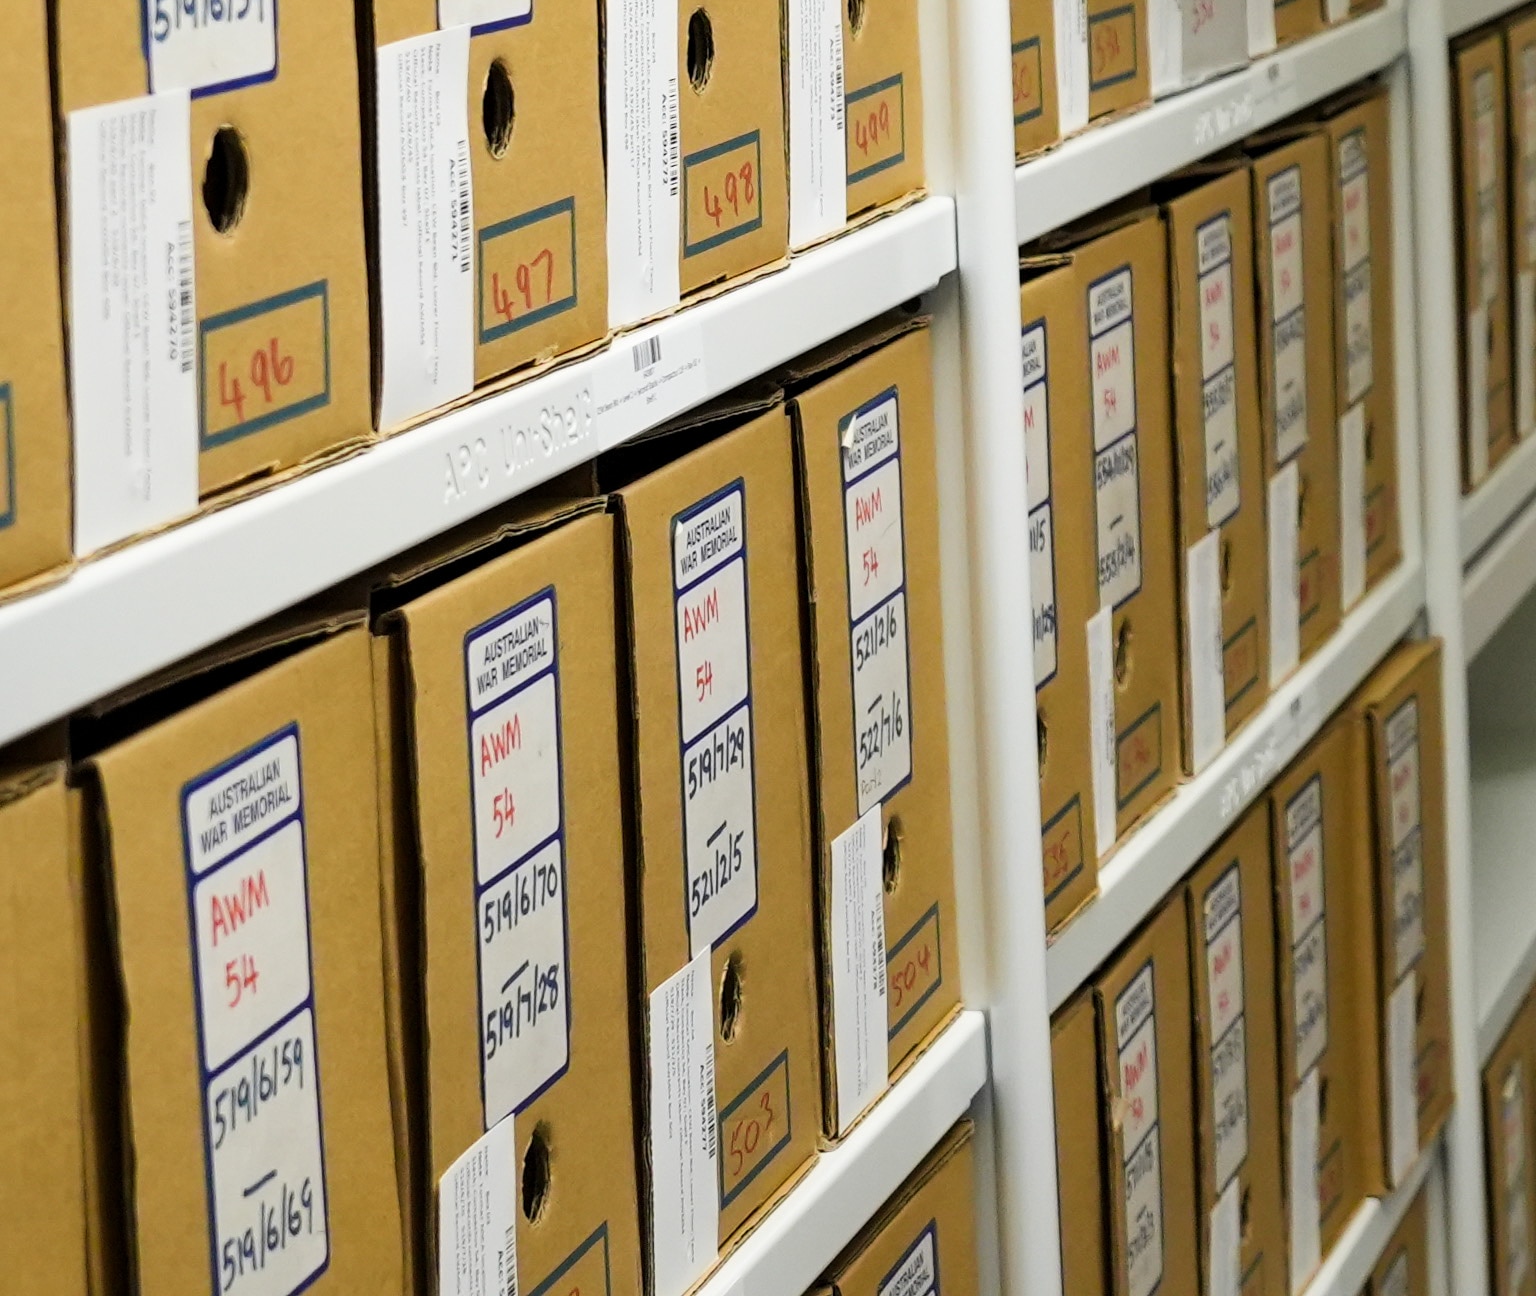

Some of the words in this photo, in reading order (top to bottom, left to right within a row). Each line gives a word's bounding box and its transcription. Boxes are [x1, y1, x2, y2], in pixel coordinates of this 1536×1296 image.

[856, 101, 890, 155] 499
[704, 160, 754, 229] 498
[168, 241, 176, 281] Acc:
[491, 248, 553, 322] 497
[219, 337, 293, 423] 496
[855, 487, 883, 532] AWM
[862, 550, 879, 588] 54
[683, 587, 719, 643] AWM
[856, 606, 897, 673] 521/2/6
[696, 659, 713, 703] 54
[481, 713, 522, 777] AWM
[688, 725, 745, 800] 519/7/29
[860, 697, 904, 772] 522/7/6
[201, 822, 228, 853] WAR
[234, 787, 292, 832] MEMORIAL
[209, 757, 281, 818] AUSTRALIAN
[492, 787, 516, 839] 54
[210, 869, 269, 946] AWM
[484, 863, 558, 944] 519/6/70
[691, 830, 744, 918] 521/2/5
[225, 953, 260, 1008] 54
[214, 1037, 304, 1151] 519/6/59
[730, 1091, 773, 1176] 503
[223, 1177, 314, 1292] 519/6/69
